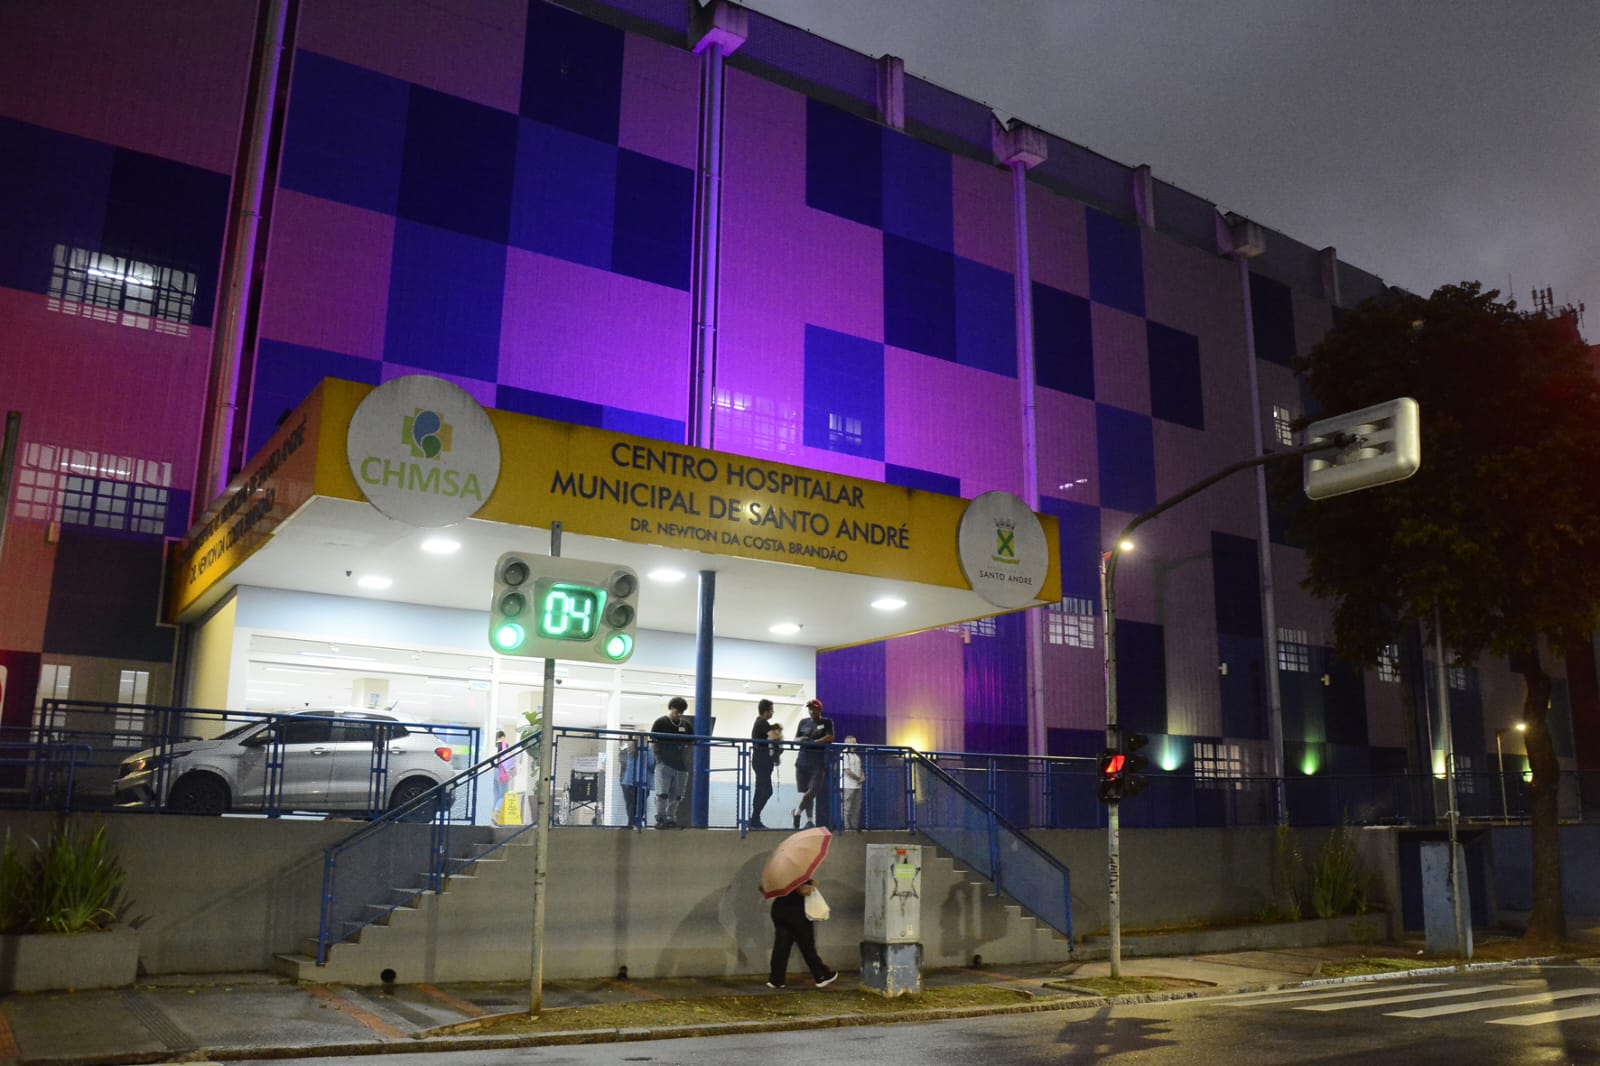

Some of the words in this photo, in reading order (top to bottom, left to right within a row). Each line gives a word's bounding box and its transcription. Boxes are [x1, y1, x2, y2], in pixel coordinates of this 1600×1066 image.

[360, 456, 482, 502] CHMSA
[611, 442, 718, 483] CENTRO
[727, 462, 865, 509] HOSPITALAR
[550, 469, 700, 516] MUNICIPAL
[709, 495, 741, 523] DE
[749, 502, 830, 536] SANTO
[836, 518, 910, 549] ANDRÉ
[630, 517, 653, 534] DR.
[657, 522, 718, 545] NEWTON
[721, 531, 741, 546] DA
[743, 535, 786, 553] COSTA
[788, 542, 848, 563] BRANDÃO
[979, 569, 1006, 582] SANTO
[543, 590, 593, 635] 04
